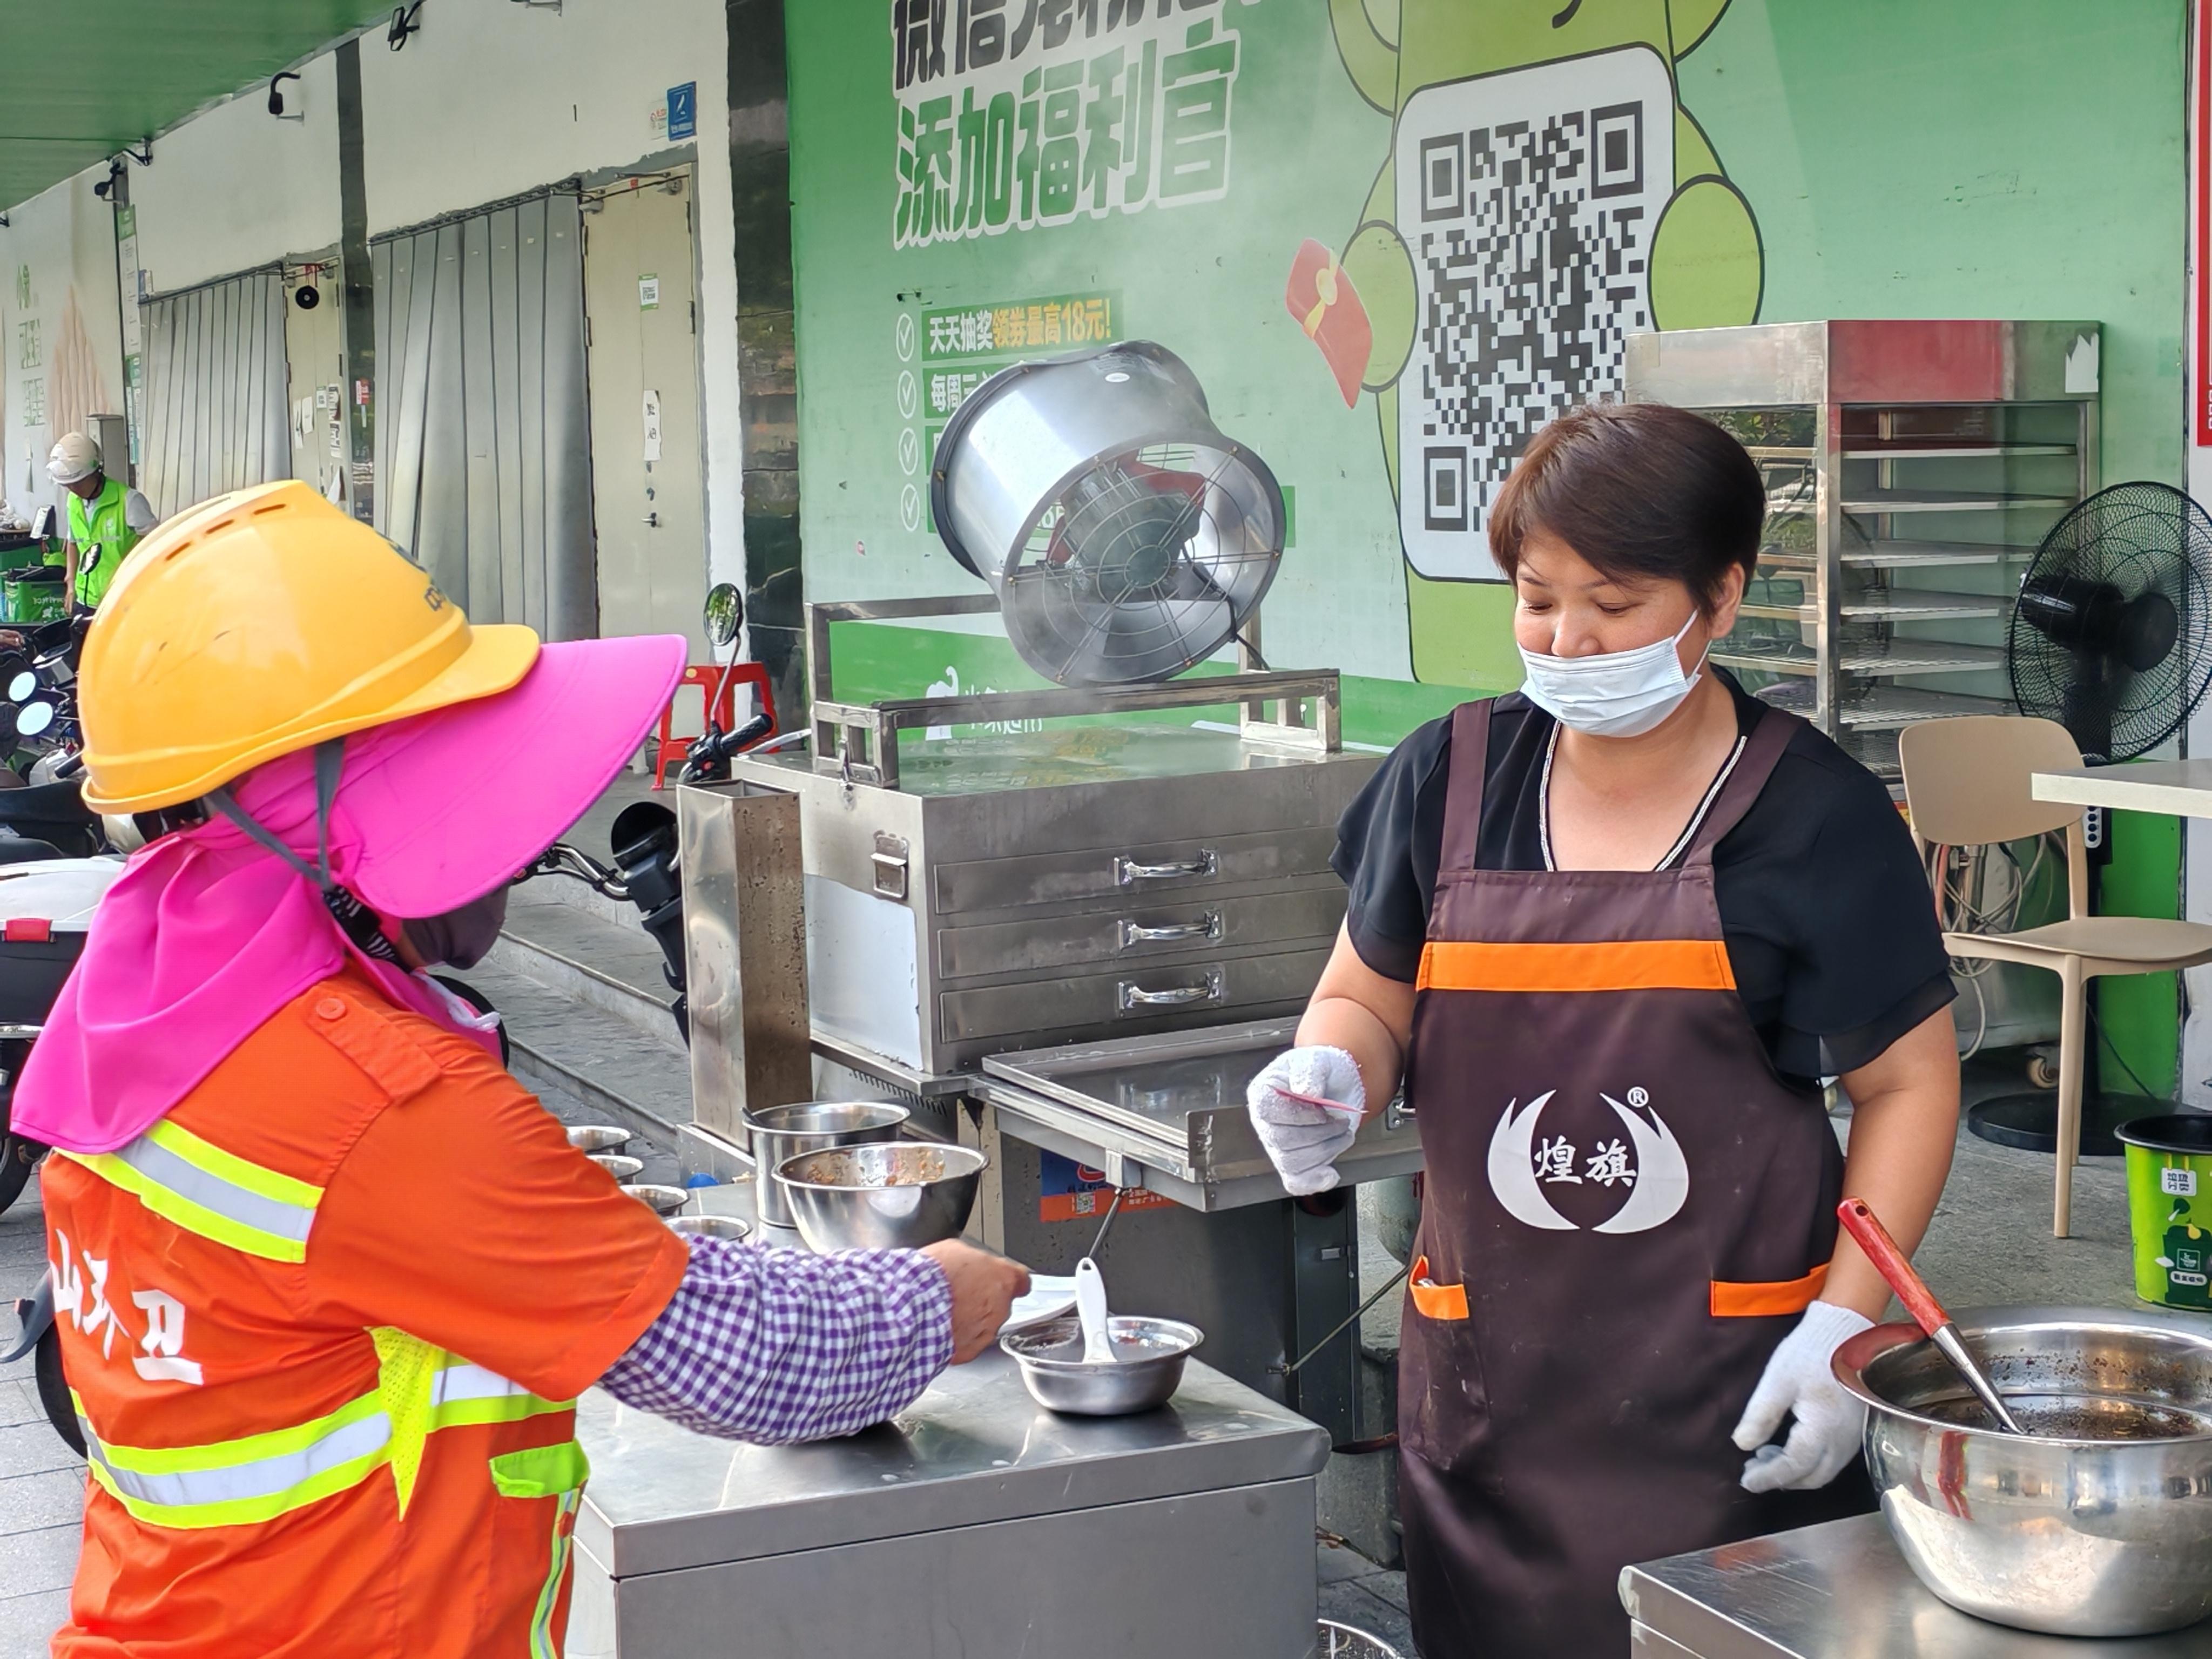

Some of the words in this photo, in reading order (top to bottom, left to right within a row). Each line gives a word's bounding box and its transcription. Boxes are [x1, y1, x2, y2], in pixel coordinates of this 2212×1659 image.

[895, 17, 1237, 244] 添加福利官
[1534, 1135, 1637, 1187] 煌旗
